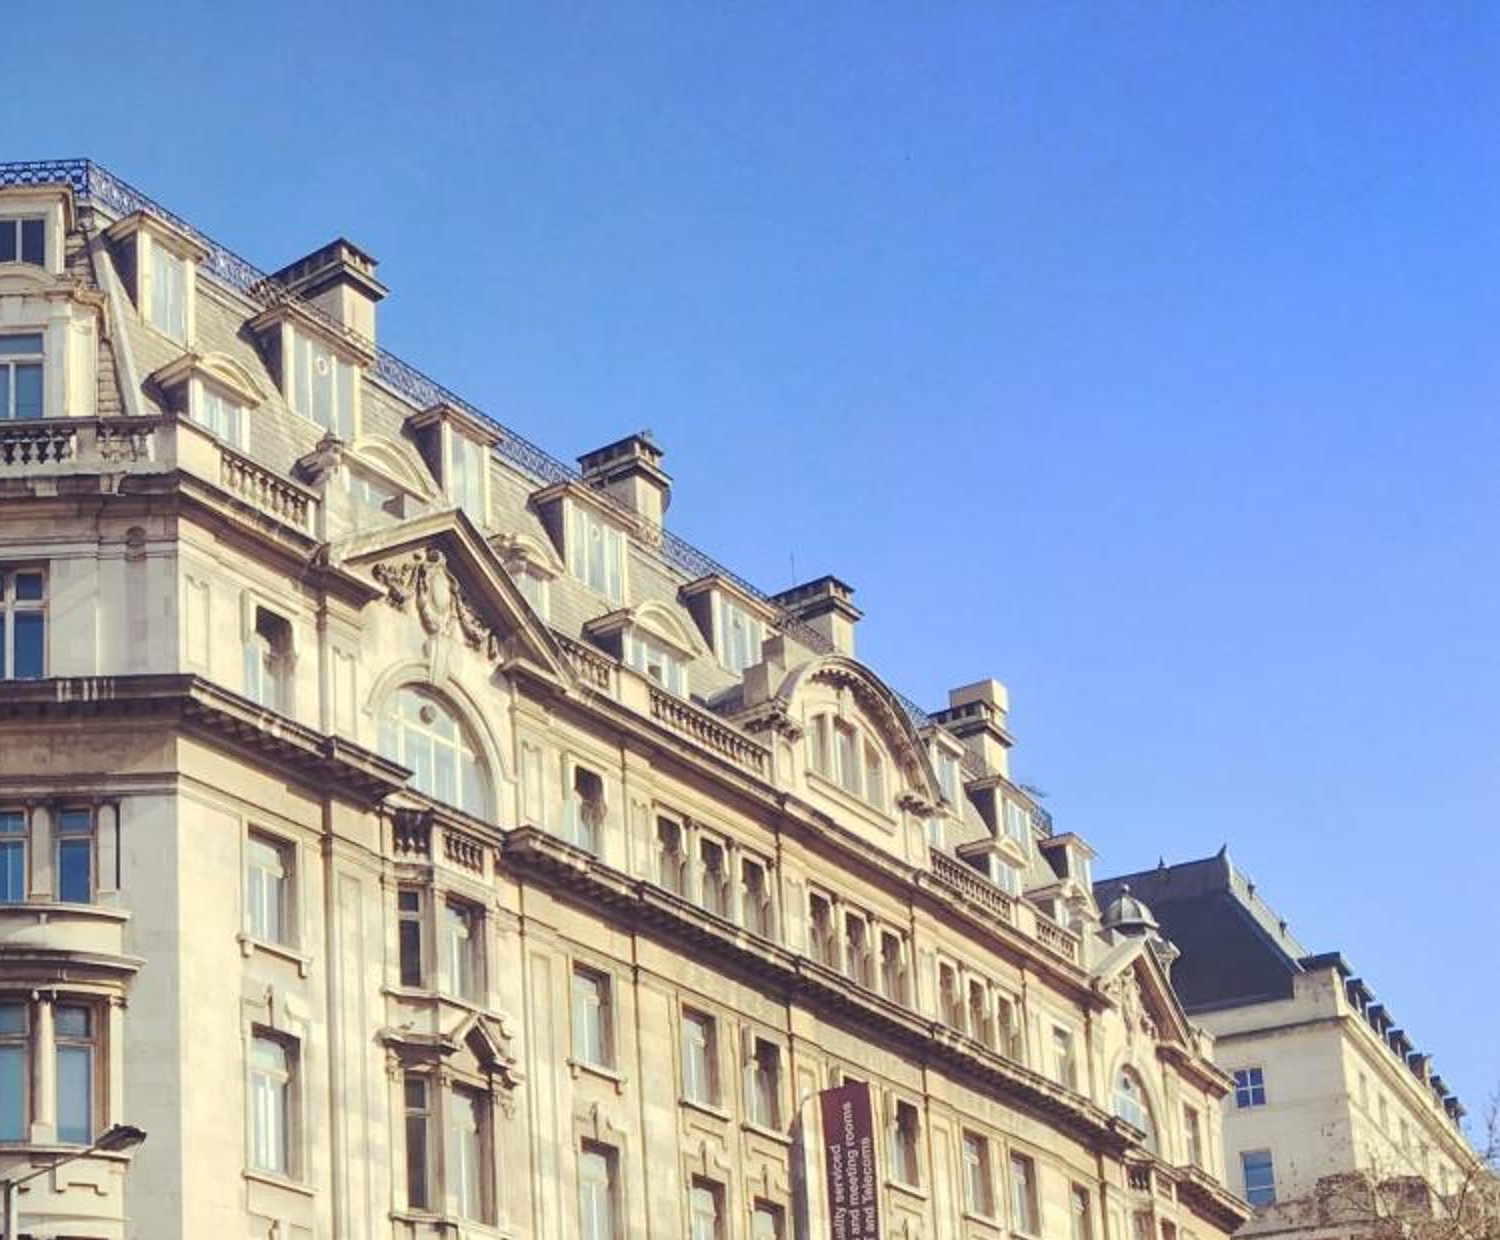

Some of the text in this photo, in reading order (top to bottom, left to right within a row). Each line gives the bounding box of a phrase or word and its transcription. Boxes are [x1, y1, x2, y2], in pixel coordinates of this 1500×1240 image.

[843, 1101, 855, 1147] rooms
[829, 1143, 845, 1203] serviced
[847, 1149, 860, 1205] meeting
[861, 1136, 875, 1204] Telecoms
[850, 1208, 861, 1235] and
[862, 1206, 875, 1232] and
